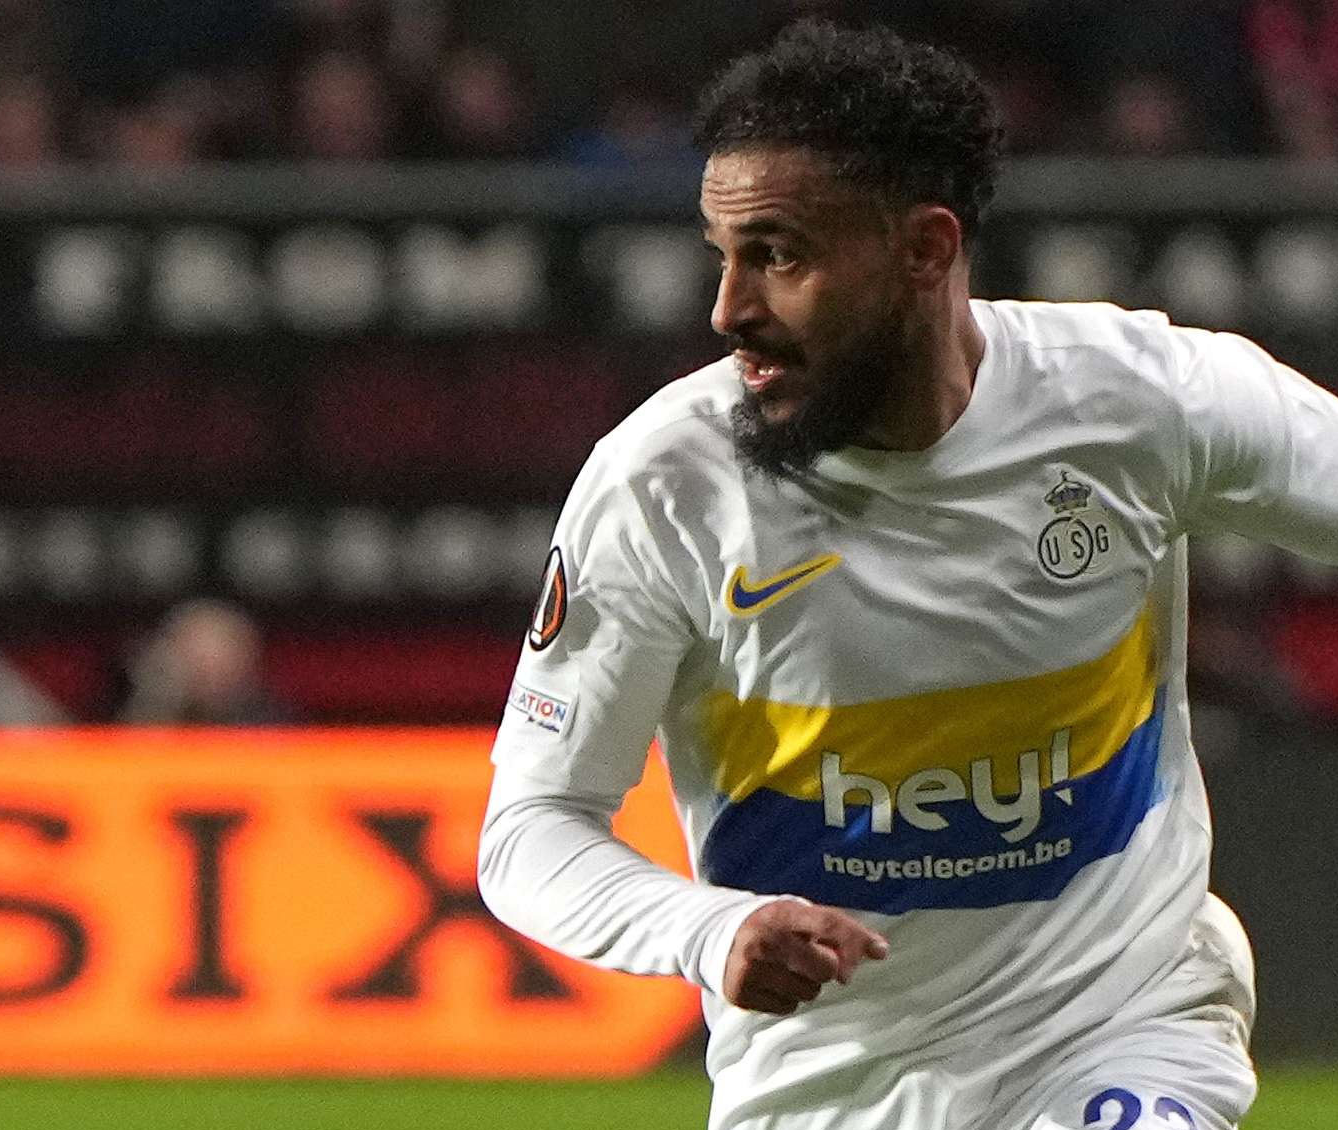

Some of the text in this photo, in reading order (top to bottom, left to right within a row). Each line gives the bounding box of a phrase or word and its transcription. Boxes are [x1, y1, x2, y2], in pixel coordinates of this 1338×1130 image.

[41, 230, 537, 331] FROM
[821, 728, 1073, 843] hey!
[823, 837, 1072, 882] heytelecom.be
